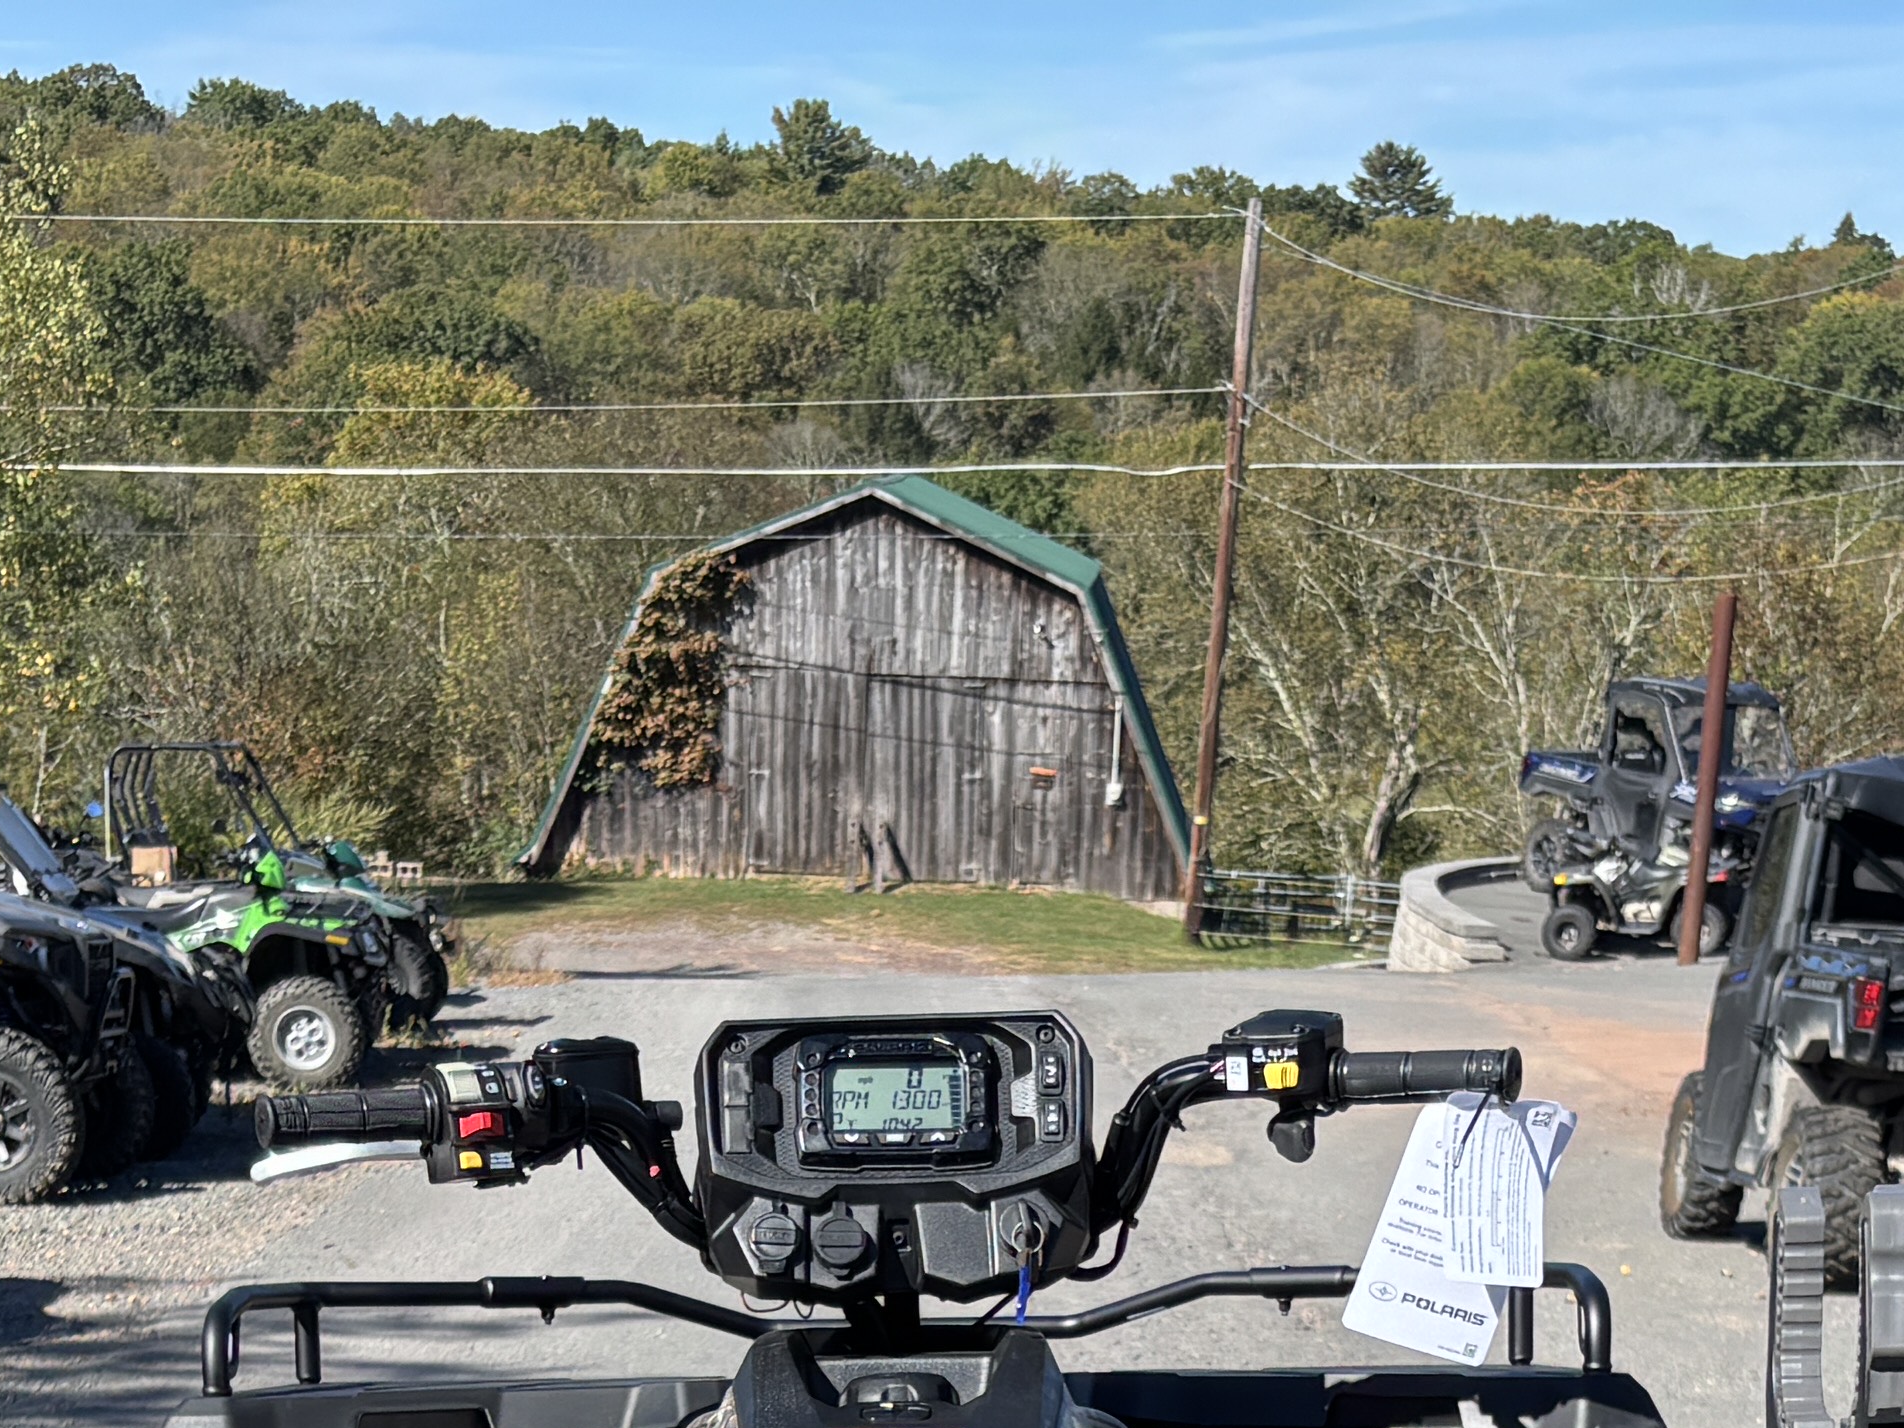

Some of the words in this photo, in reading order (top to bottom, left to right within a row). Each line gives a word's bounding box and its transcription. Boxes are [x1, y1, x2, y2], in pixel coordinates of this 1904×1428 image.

[833, 1091, 870, 1109] RPM
[892, 1090, 942, 1109] 1300
[1401, 1292, 1489, 1326] POLARIS
